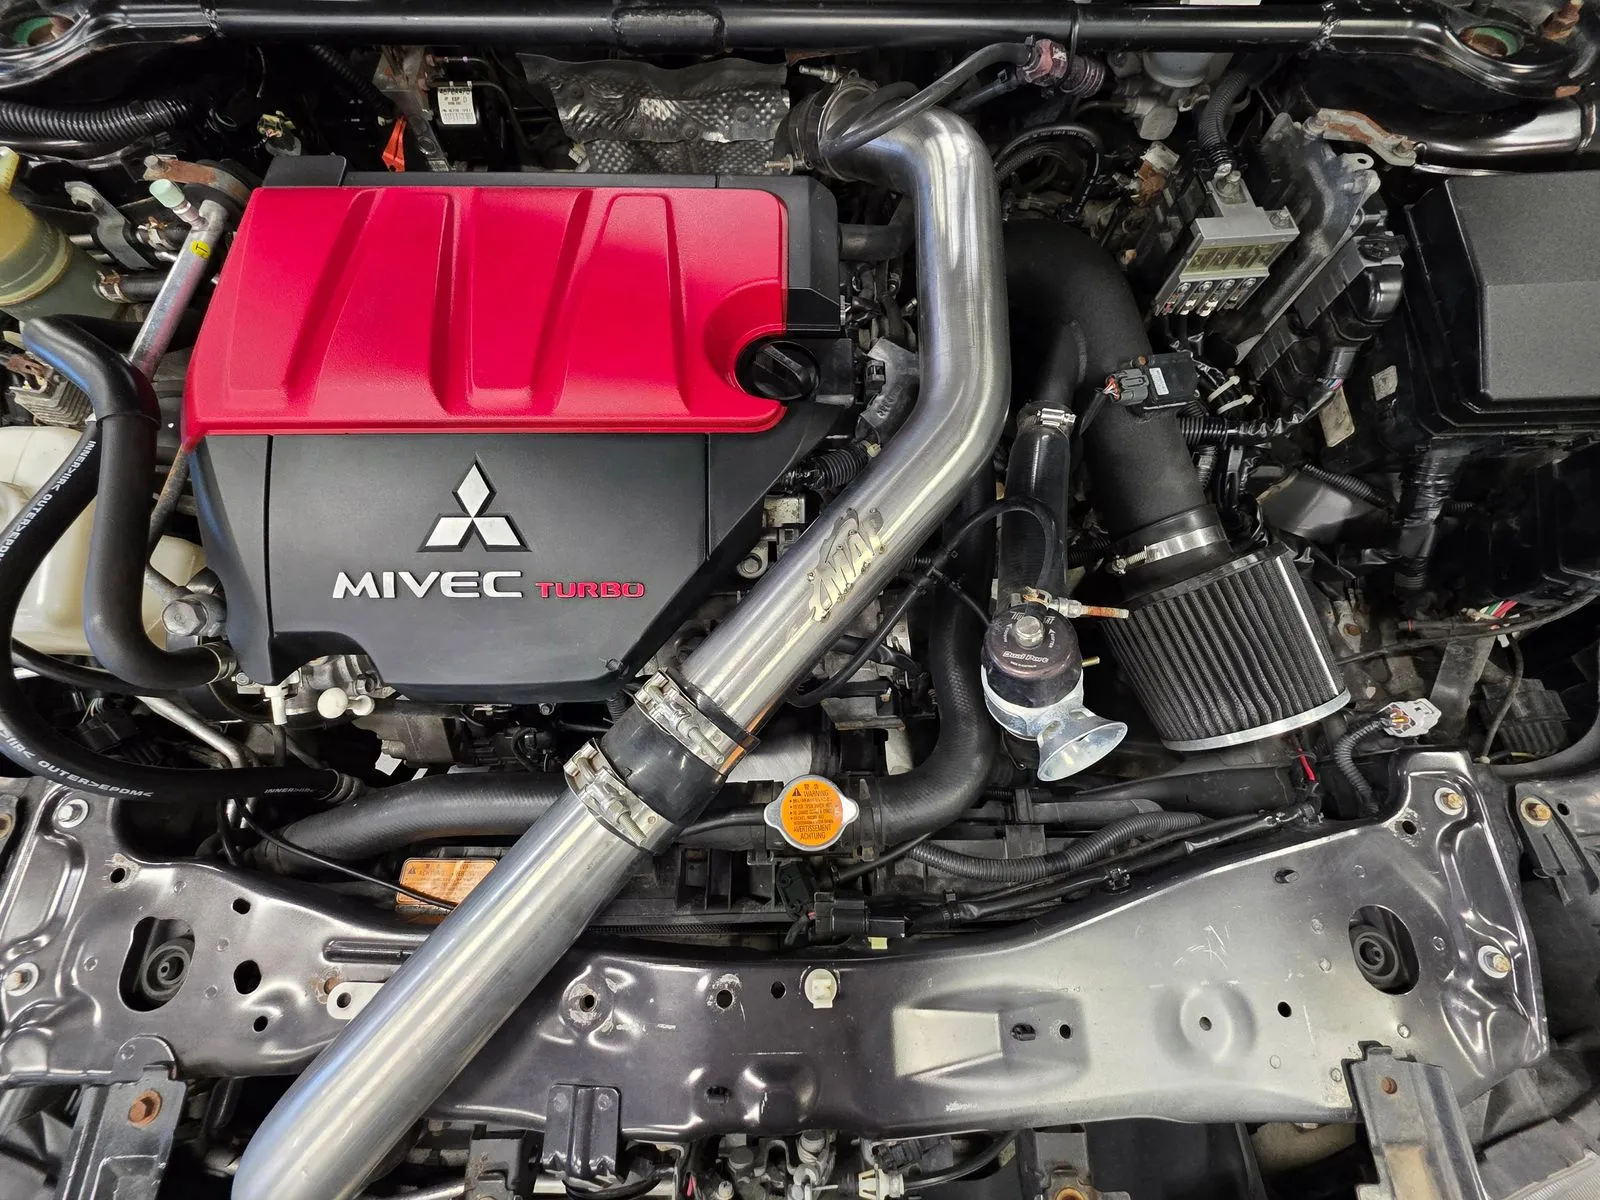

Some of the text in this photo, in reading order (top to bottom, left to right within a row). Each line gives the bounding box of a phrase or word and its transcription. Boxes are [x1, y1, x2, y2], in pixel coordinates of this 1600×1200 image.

[332, 570, 645, 599] MIVEC TURBO
[800, 832, 826, 840] ACHTUNG
